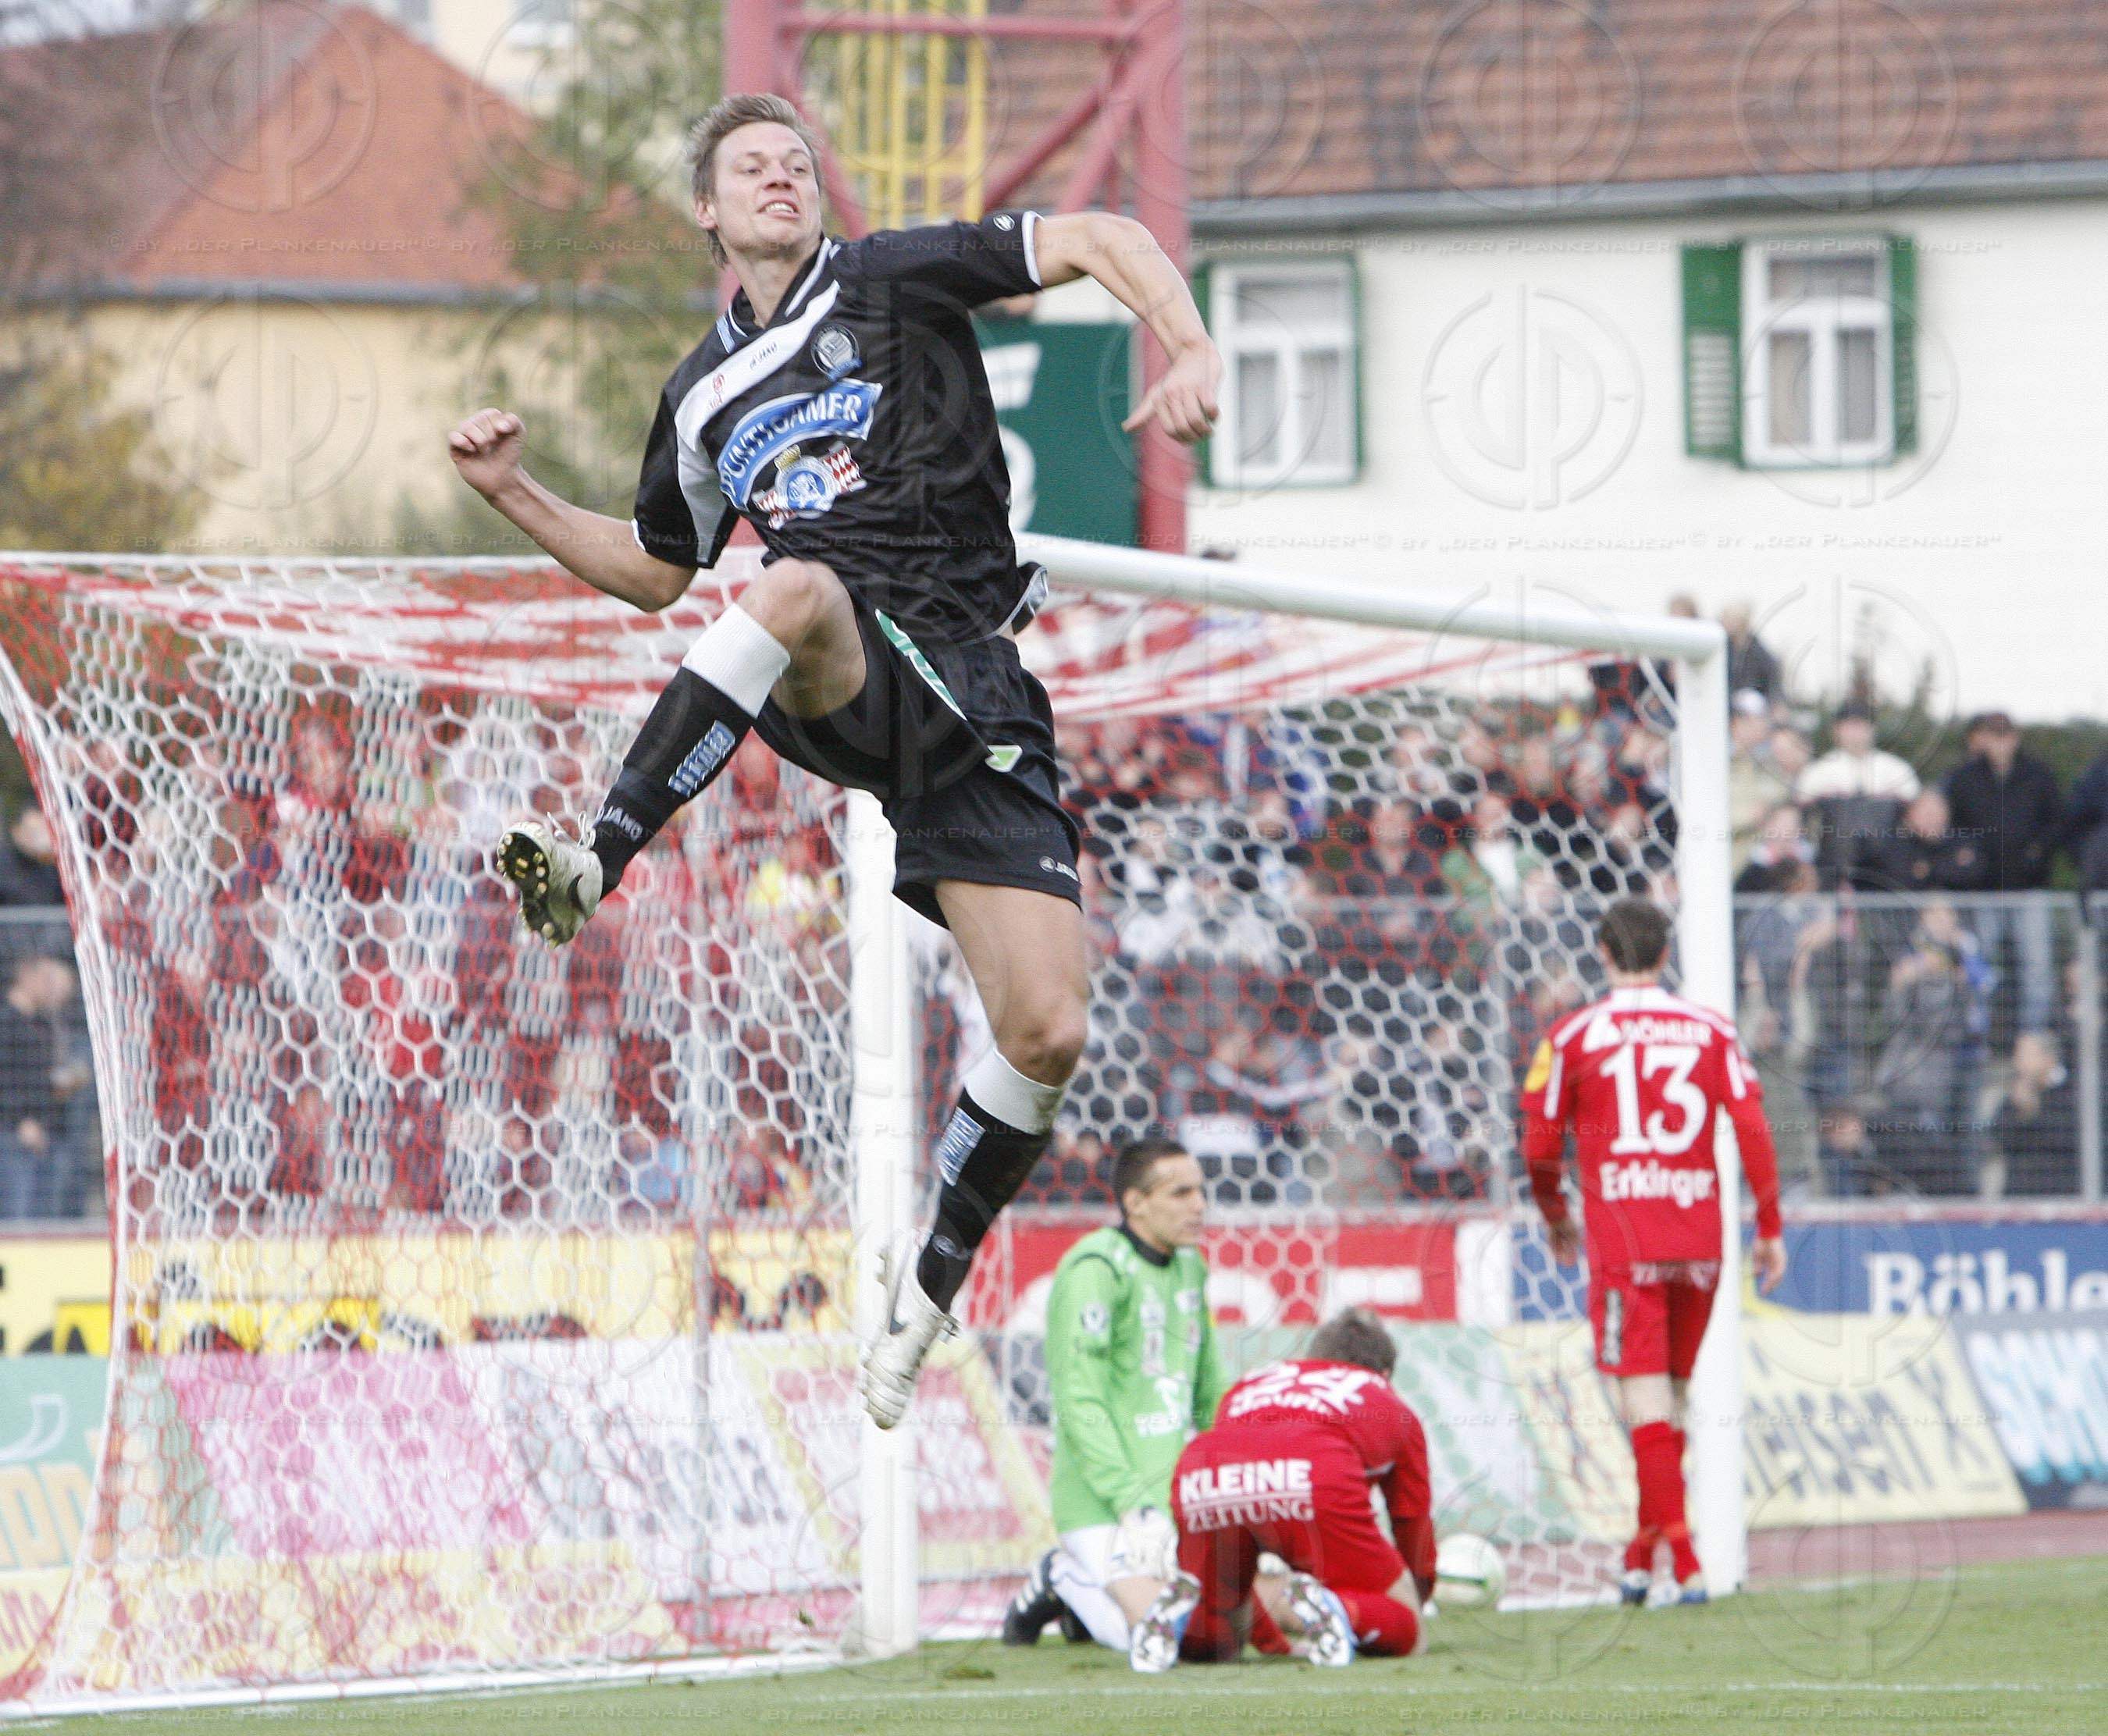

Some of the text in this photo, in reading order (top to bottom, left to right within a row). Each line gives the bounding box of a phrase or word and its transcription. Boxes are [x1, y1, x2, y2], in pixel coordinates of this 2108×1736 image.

[1599, 1044, 1707, 1155] 13
[1180, 1458, 1312, 1504] KLEINE
[1185, 1499, 1315, 1534] ZEITUNG
